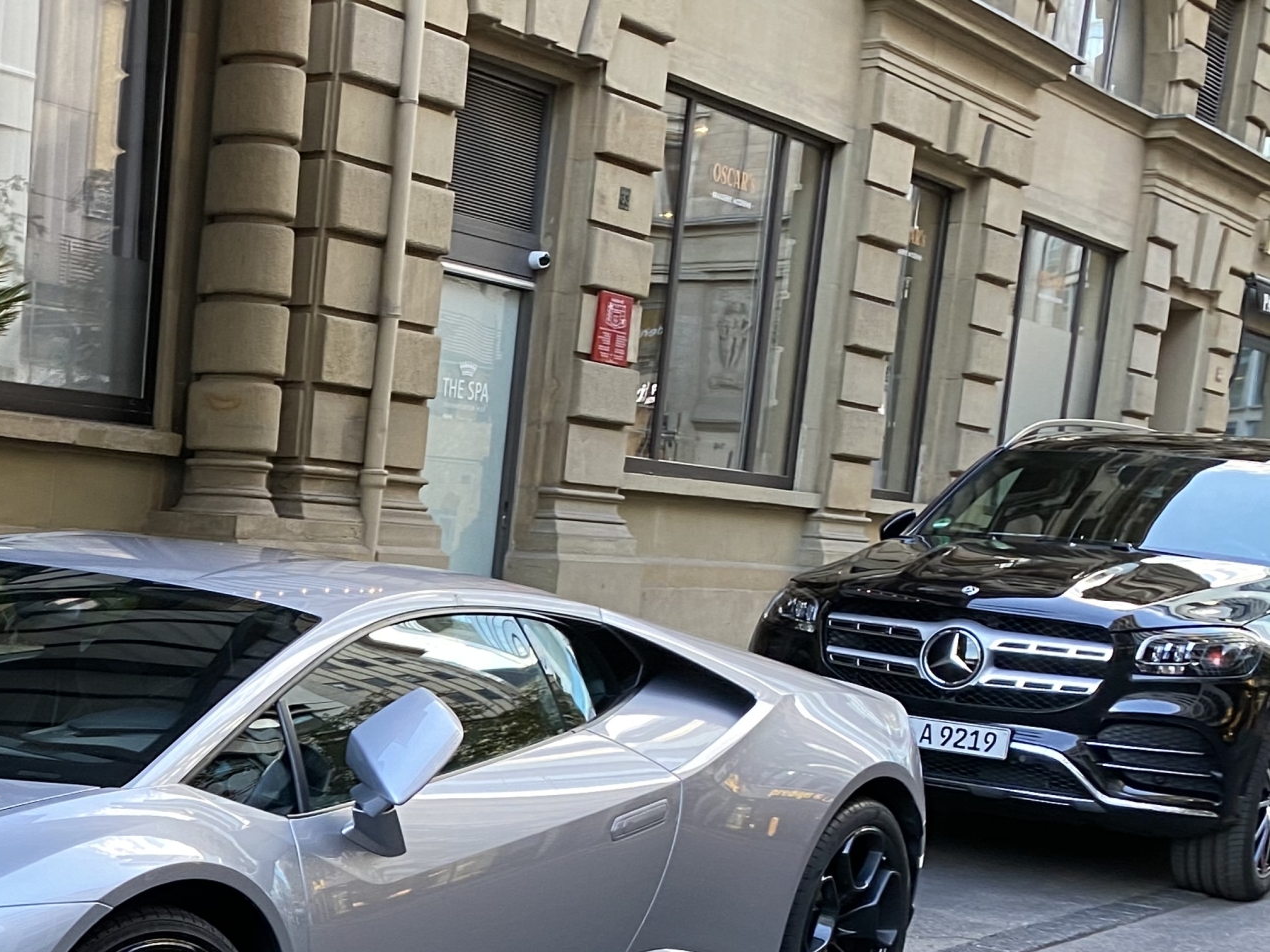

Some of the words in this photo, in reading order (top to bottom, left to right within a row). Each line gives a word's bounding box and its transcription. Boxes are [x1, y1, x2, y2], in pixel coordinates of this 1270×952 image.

[443, 377, 465, 400] THE
[467, 381, 489, 403] SPA
[919, 723, 932, 745] A
[940, 726, 997, 753] 9219
